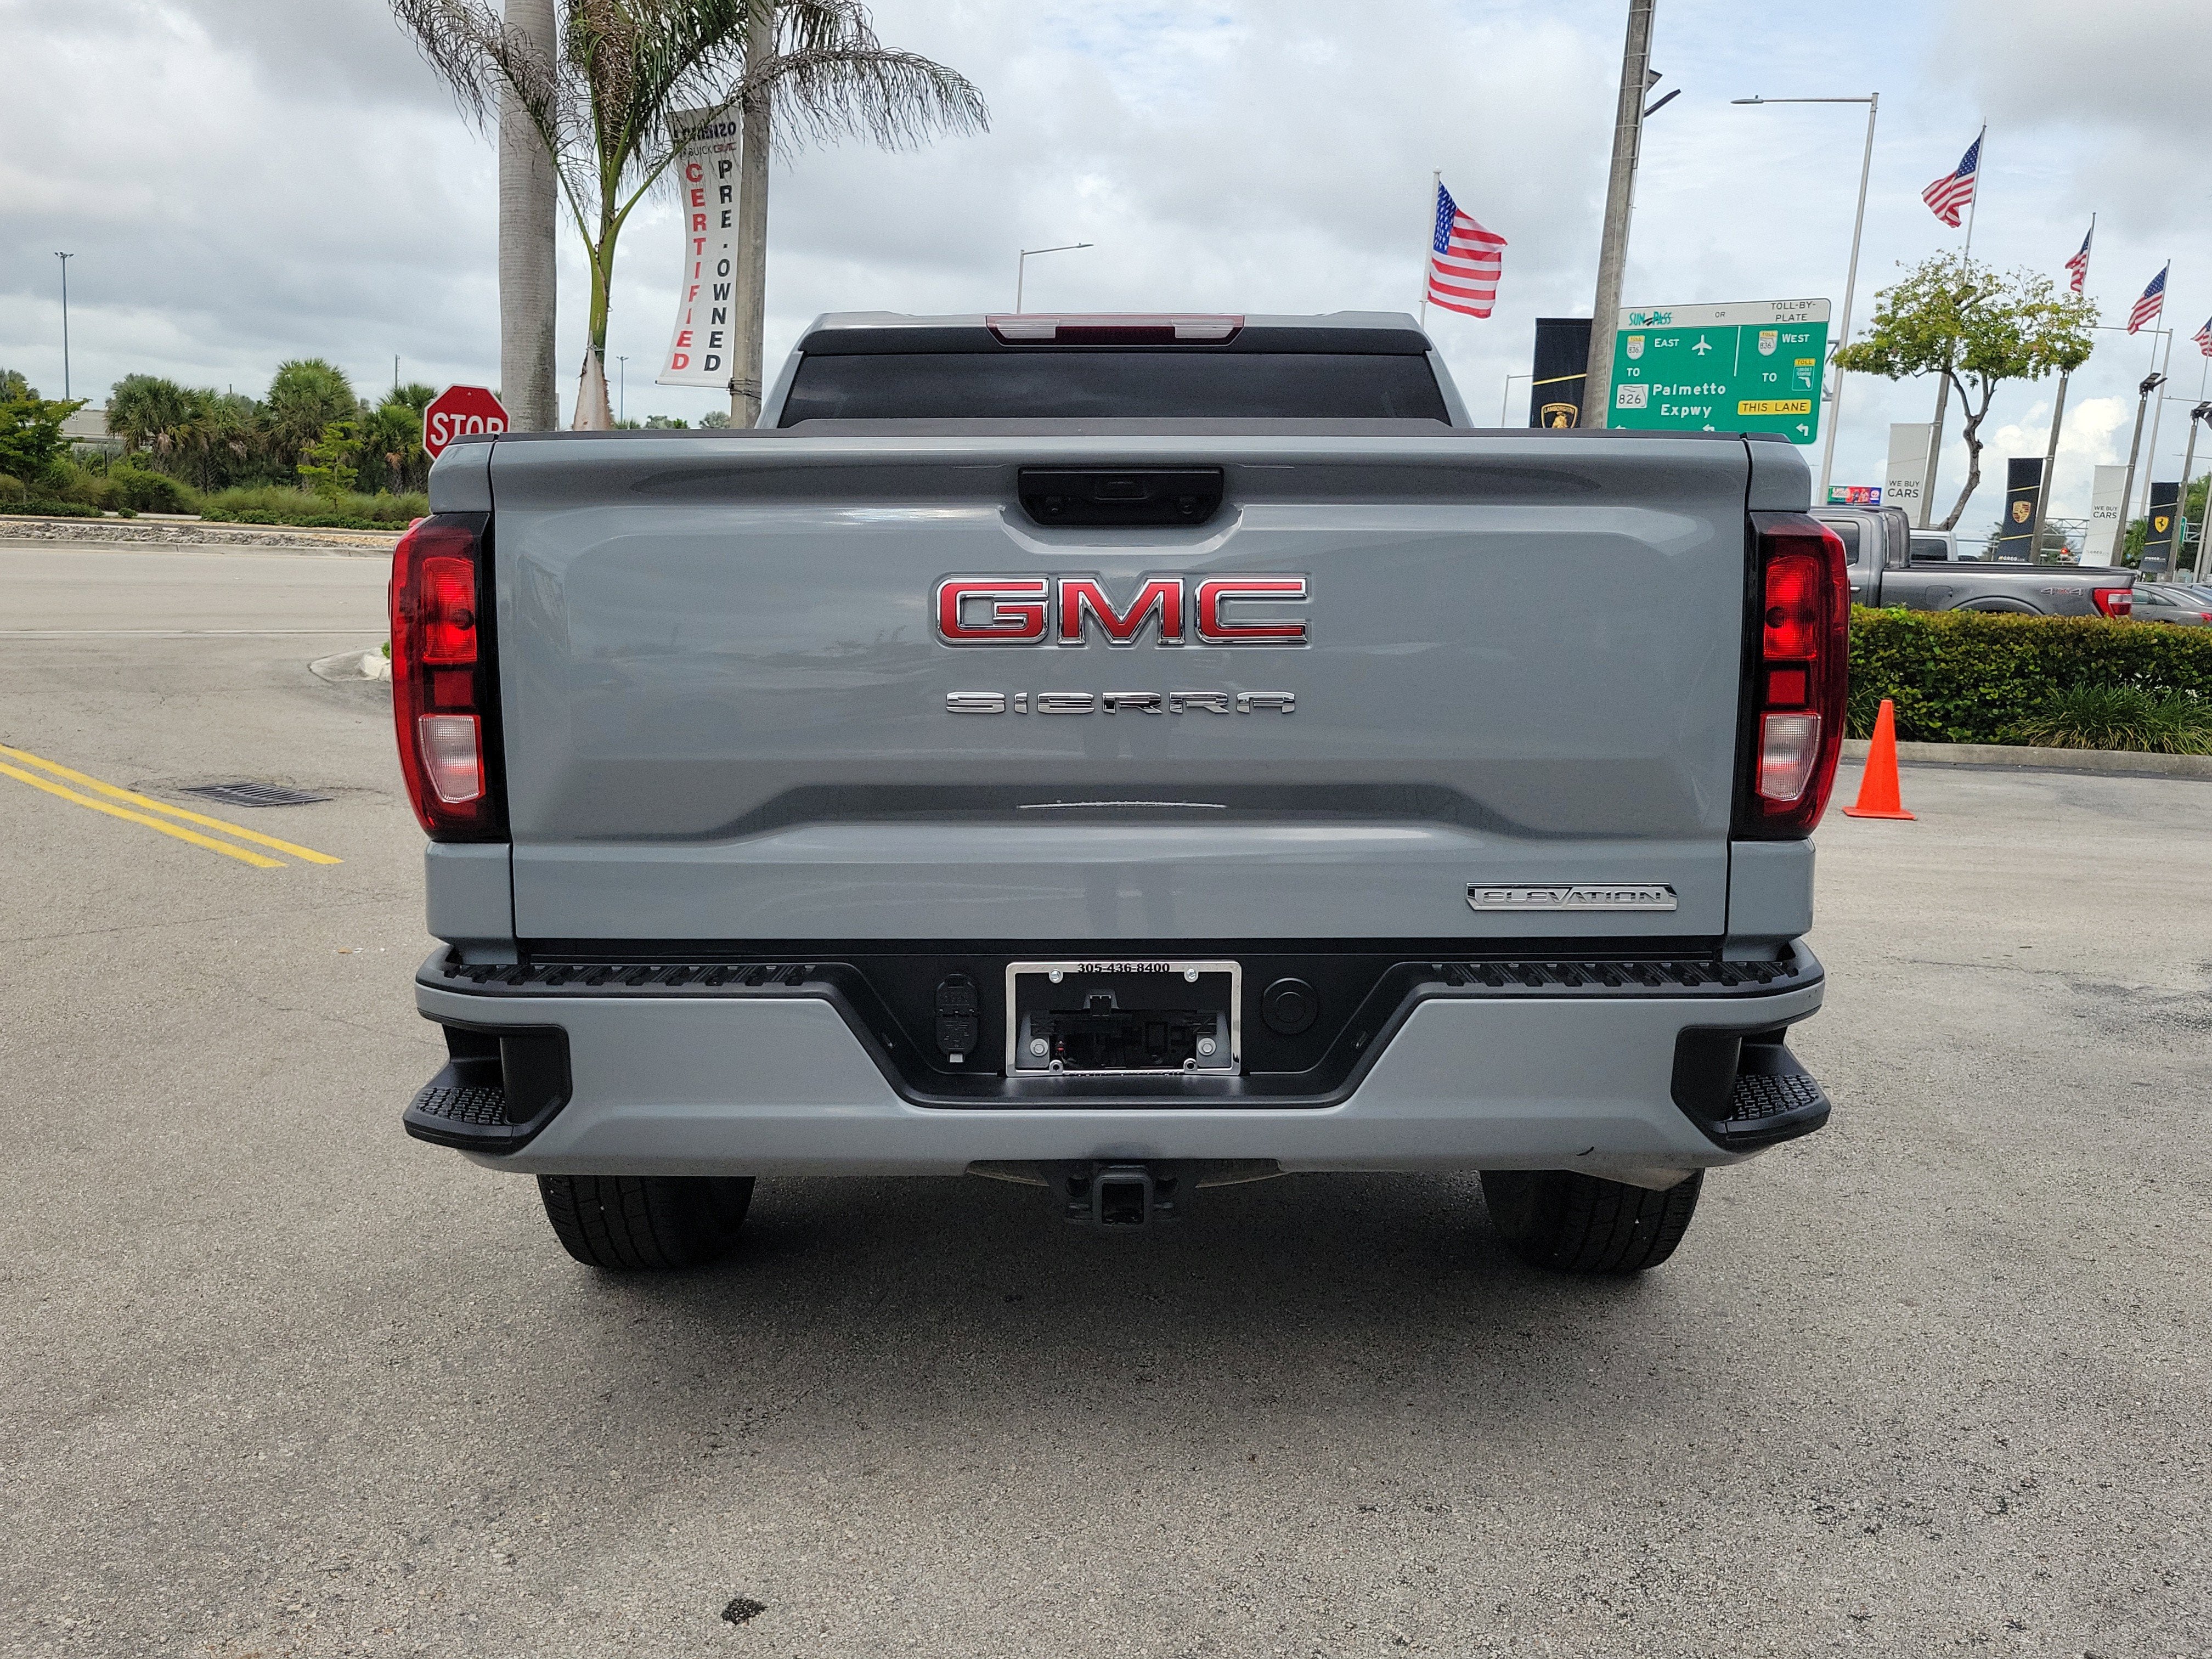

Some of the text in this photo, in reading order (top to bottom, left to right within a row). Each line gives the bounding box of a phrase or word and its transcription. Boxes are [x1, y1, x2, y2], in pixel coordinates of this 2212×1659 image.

[689, 145, 712, 156] BUICK
[672, 163, 707, 370] CERTIFIED
[1775, 313, 1808, 322] PLATE
[1654, 338, 1680, 347] EAST
[1782, 334, 1810, 343] WEST
[1627, 368, 1640, 377] TO
[1762, 373, 1777, 382] TO
[1652, 382, 1726, 396] Palmetto
[1618, 394, 1641, 404] 826
[1661, 404, 1712, 419] Expwy
[1742, 403, 1807, 412] THIS LANE
[430, 412, 504, 446] STOP
[1887, 488, 1919, 498] CARS
[936, 577, 1308, 645] GMC
[946, 691, 1296, 714] SIERRA
[1483, 890, 1662, 904] ELEVATION
[1077, 963, 1170, 973] 305-436-8400
